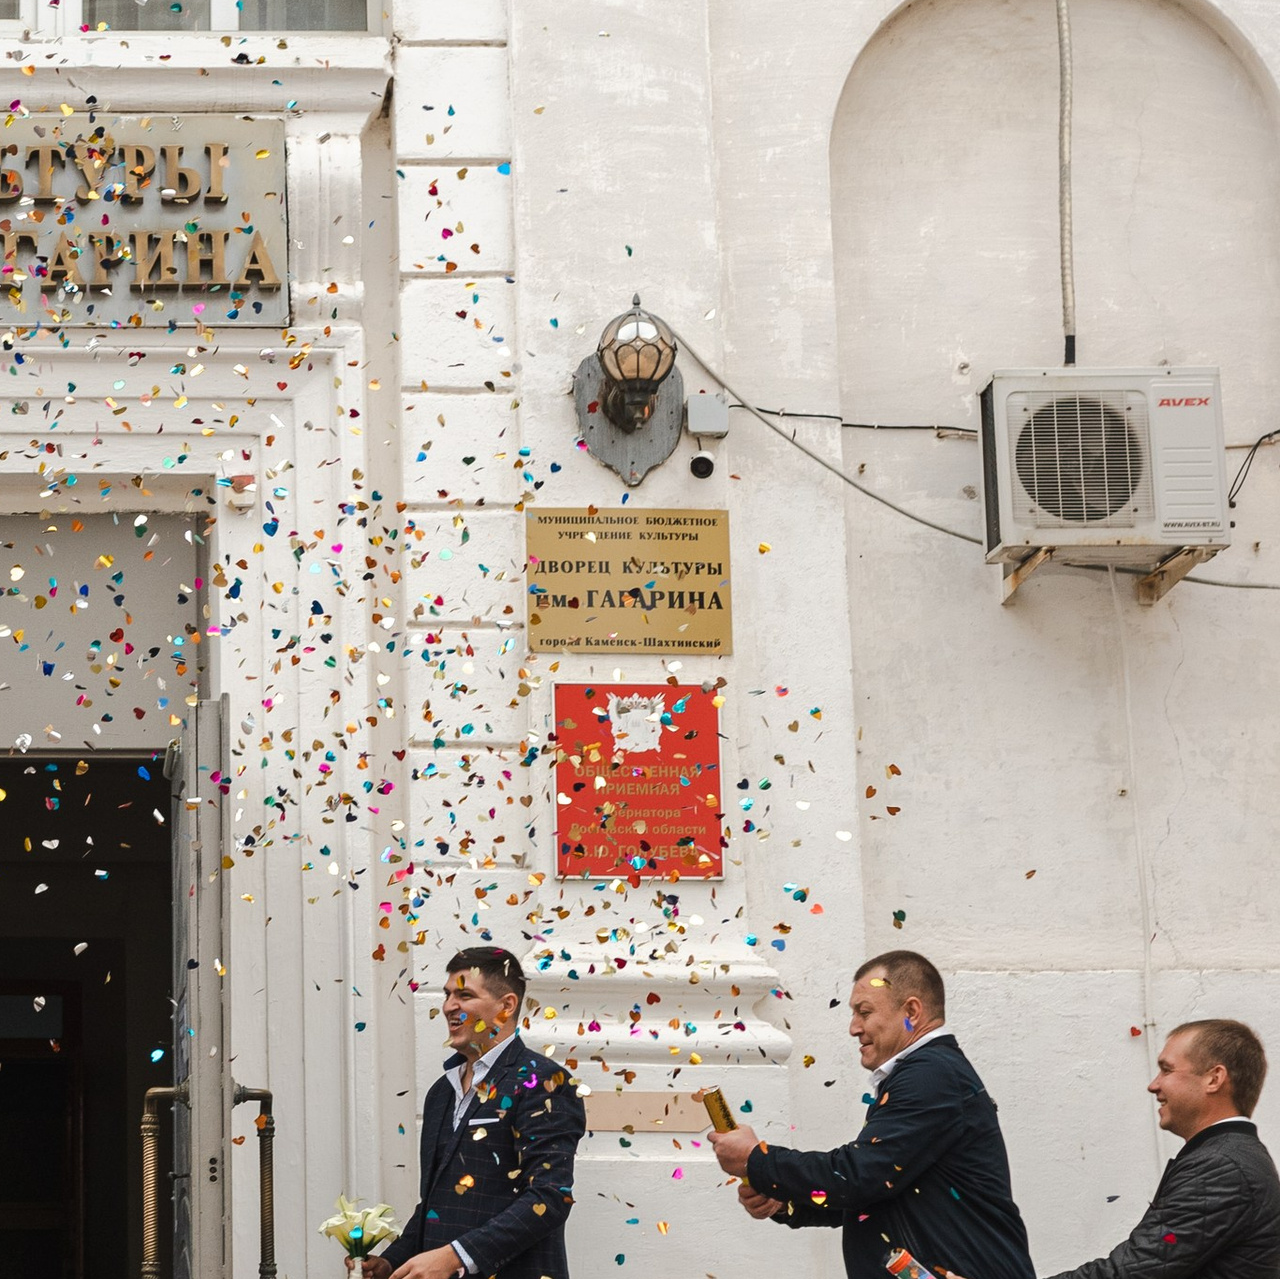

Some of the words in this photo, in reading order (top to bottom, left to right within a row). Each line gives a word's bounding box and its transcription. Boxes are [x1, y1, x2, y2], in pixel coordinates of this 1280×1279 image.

[1158, 396, 1211, 407] AVEX
[537, 515, 640, 525] МУНИЦИПАЛЬНОЕ
[645, 516, 719, 527] БЮДЖЕТНОЕ
[558, 531, 633, 540] УЧРЕДЕНИЕ
[638, 531, 699, 541] КУЛЬТУРЫ
[534, 560, 611, 575] ДВОРЕЦ
[622, 560, 723, 576] КУЛЬТУРЫ
[586, 589, 724, 610] ГАГАРИНА
[585, 636, 721, 648] Каменск-Шахтинский
[574, 765, 700, 779] ОБЩЕСЕННАЯ
[652, 823, 707, 835] области
